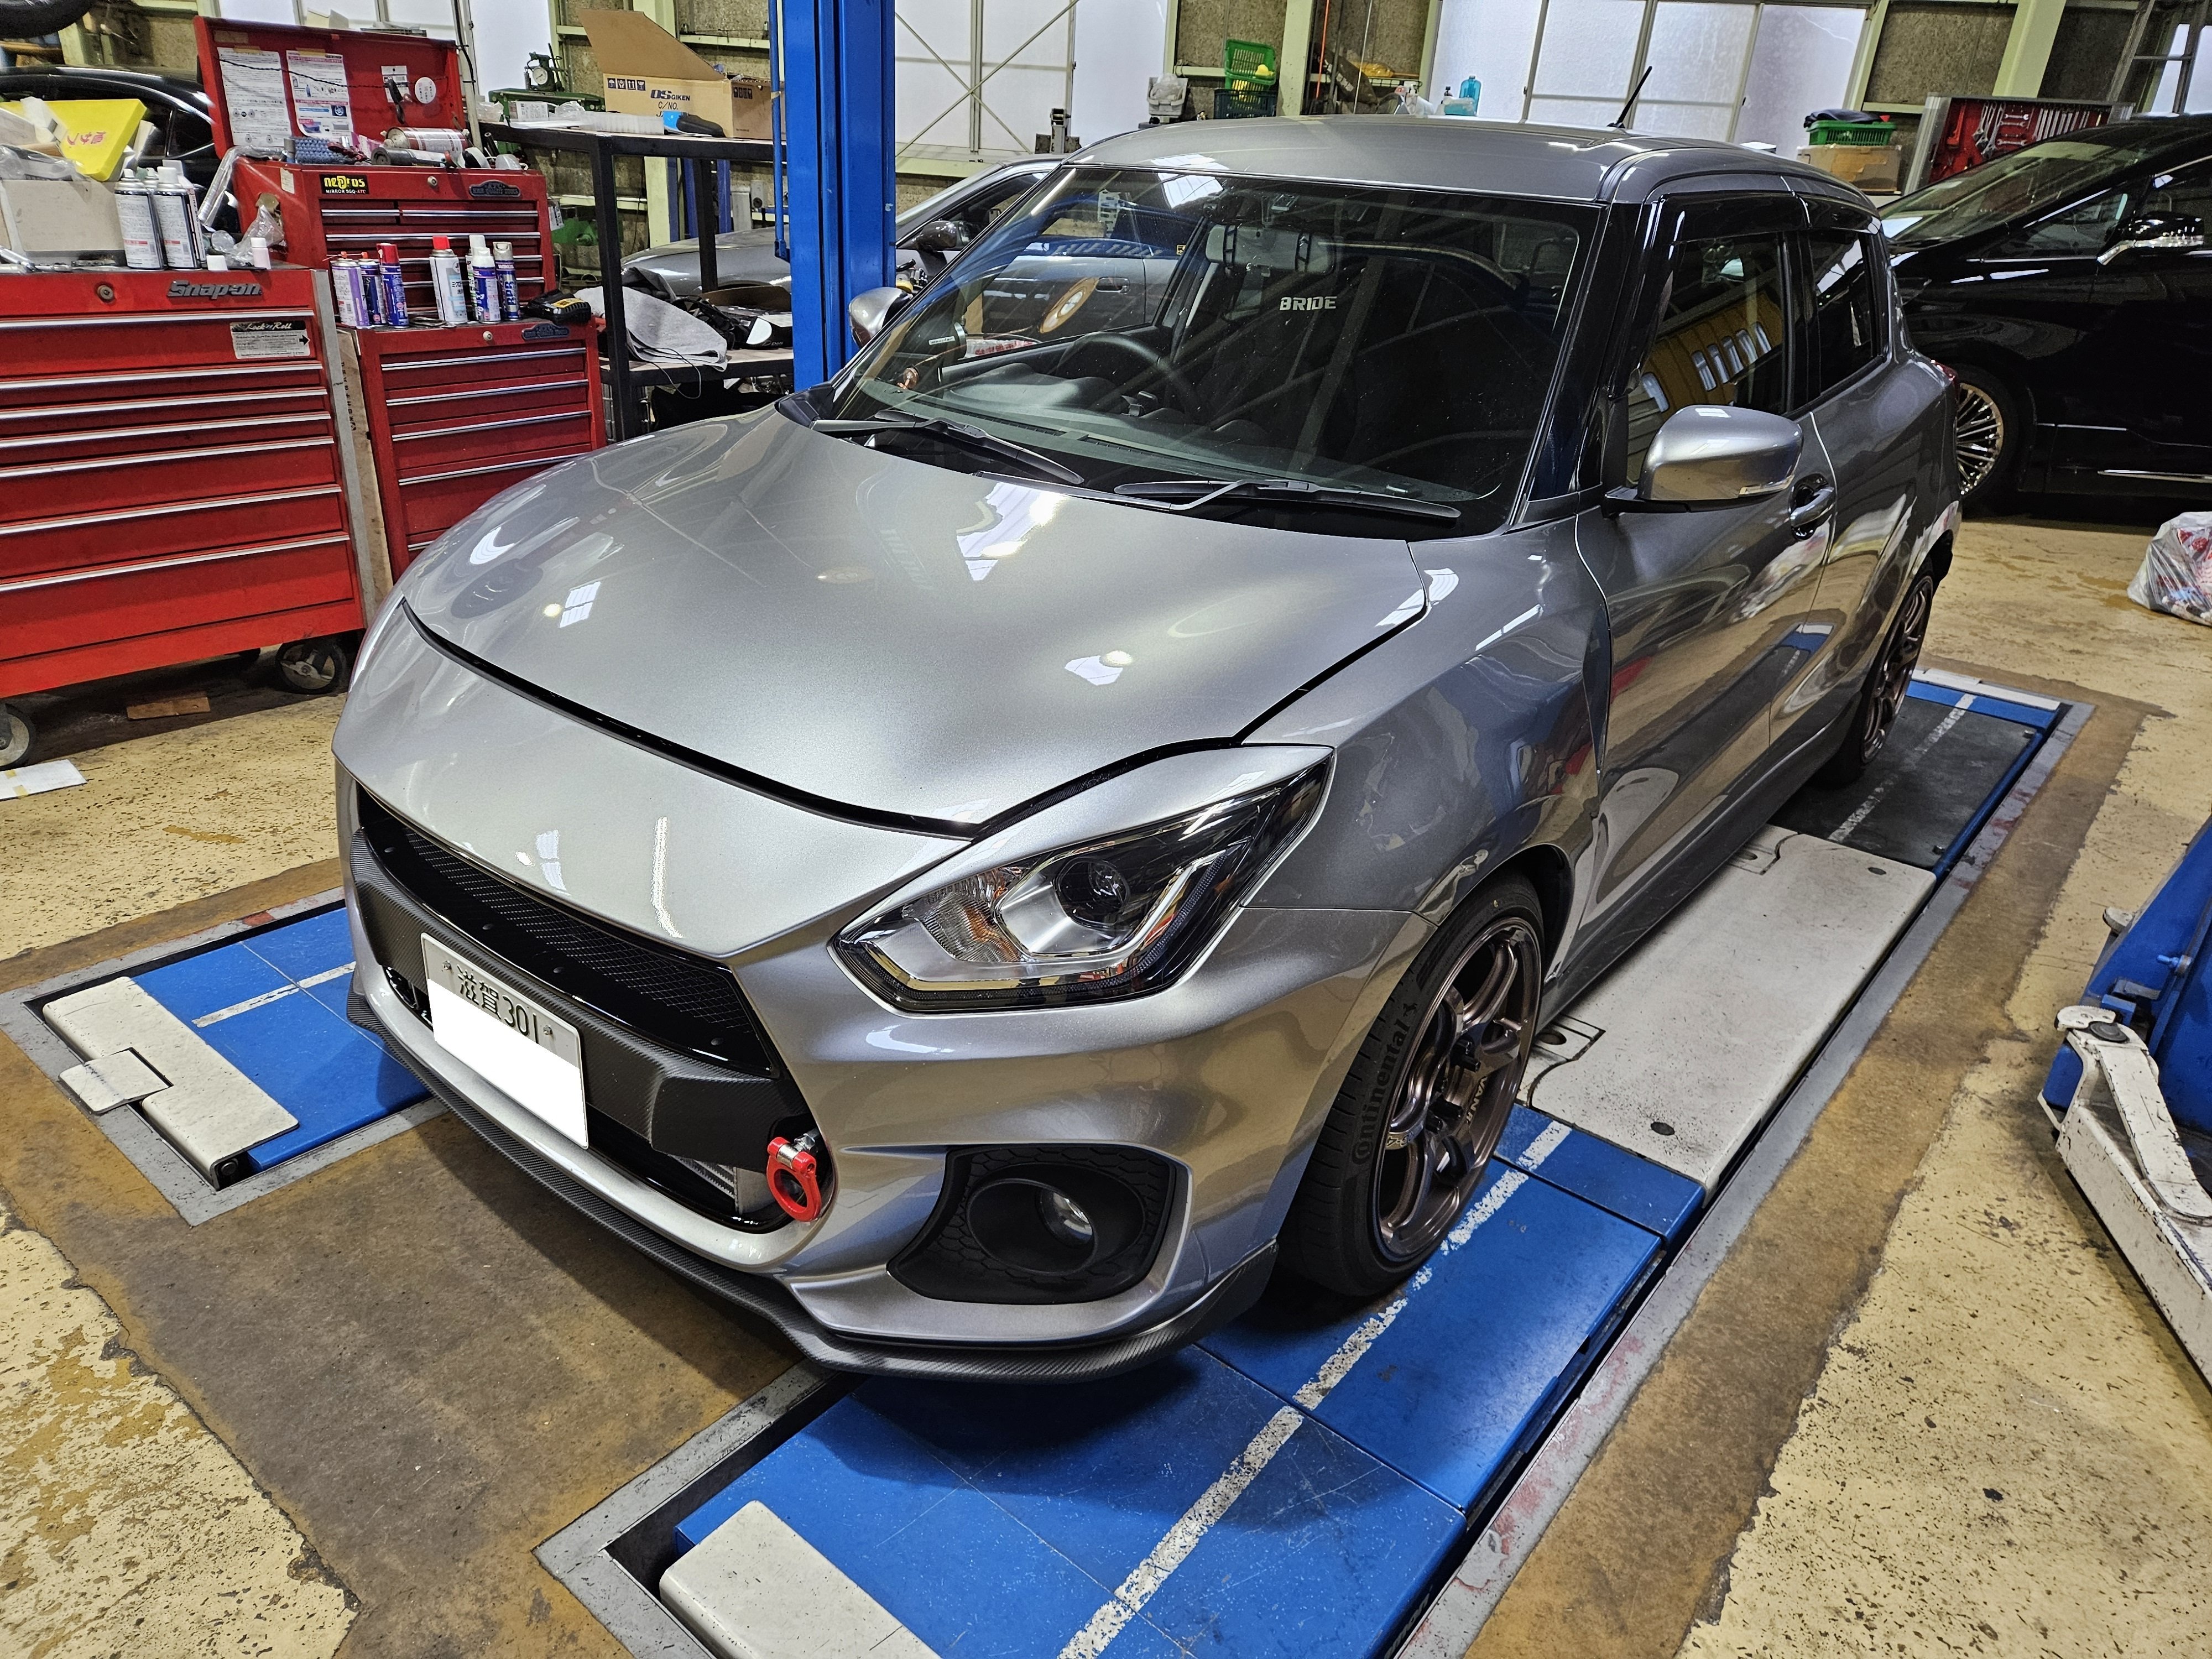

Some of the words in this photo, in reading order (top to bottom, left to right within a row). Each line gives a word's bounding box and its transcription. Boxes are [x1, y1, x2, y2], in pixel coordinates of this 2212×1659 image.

[658, 101, 679, 110] C/NO.
[168, 280, 260, 299] Snap-on
[1279, 296, 1337, 310] BRIDE
[272, 322, 292, 330] Roll
[1353, 1019, 1410, 1165] Continental
